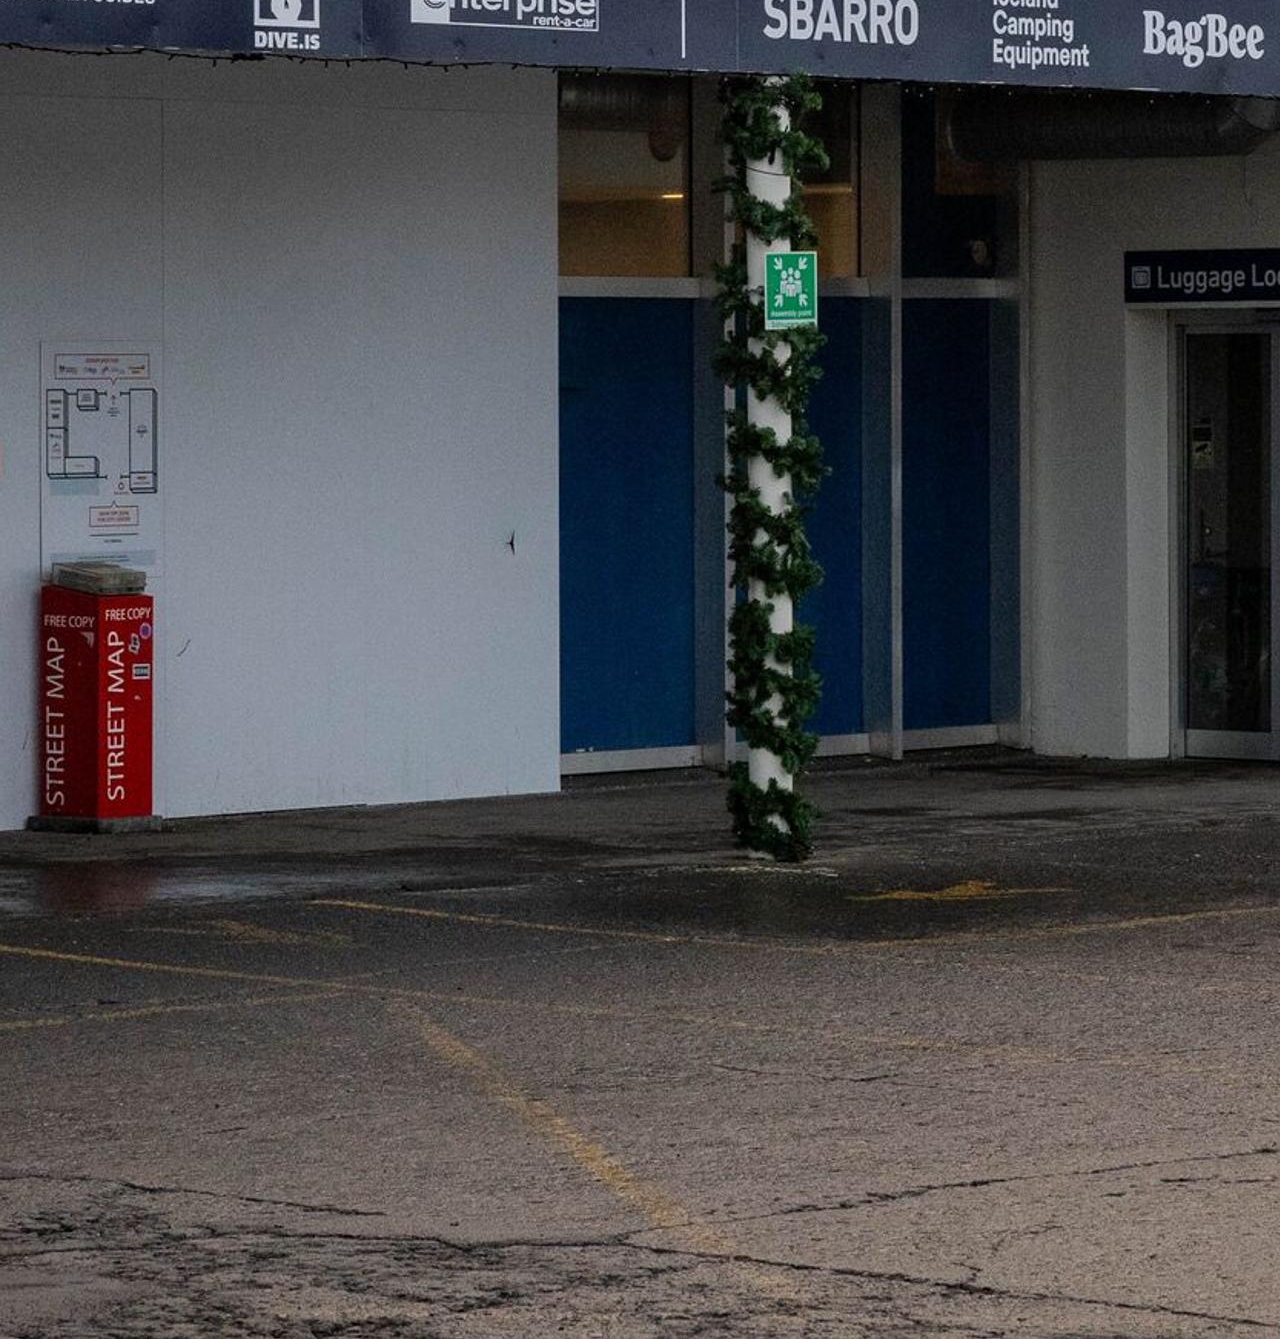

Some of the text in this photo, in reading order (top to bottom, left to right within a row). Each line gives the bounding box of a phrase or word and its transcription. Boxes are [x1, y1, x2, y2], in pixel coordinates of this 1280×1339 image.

[532, 15, 597, 29] rent-a-car
[993, 10, 1074, 43] Camping
[254, 30, 320, 50] DIVE.IS
[993, 39, 1090, 68] Equipment
[1142, 11, 1265, 67] BagBee
[1157, 265, 1246, 294] Luggage
[43, 614, 95, 628] FREE COPY
[105, 606, 151, 621] FREE COPY
[46, 637, 65, 805] STREET MAP
[107, 630, 125, 800] STREET MAP
